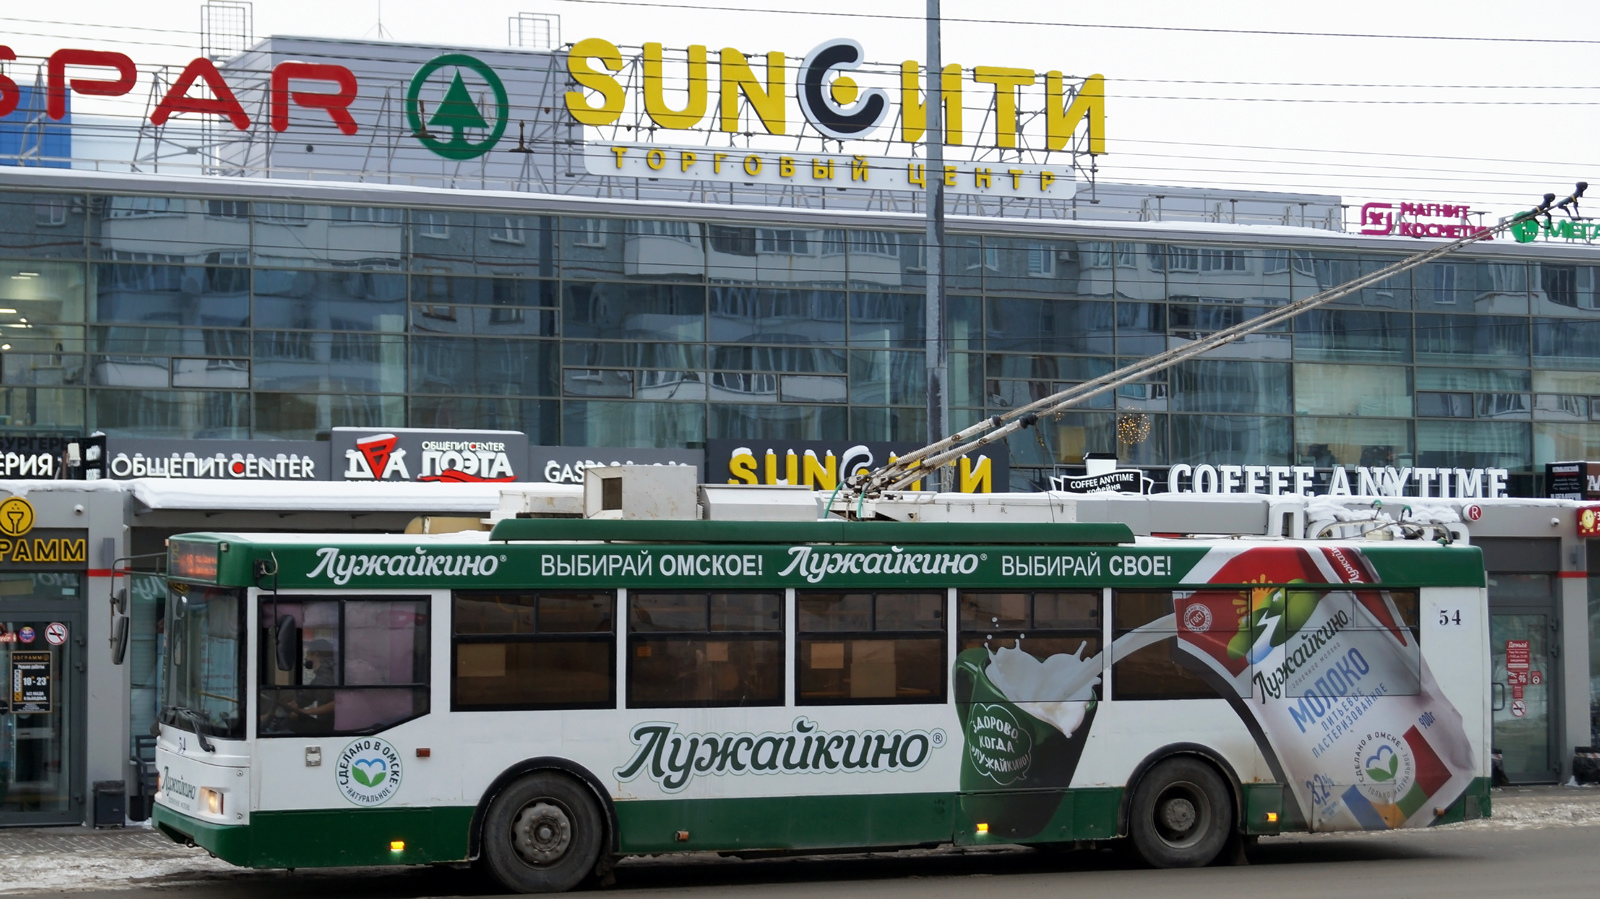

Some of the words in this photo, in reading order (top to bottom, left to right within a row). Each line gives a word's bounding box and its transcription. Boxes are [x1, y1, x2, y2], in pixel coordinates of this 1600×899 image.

[0, 44, 358, 136] PAR
[610, 146, 869, 182] ТОРГОВЫЙ
[908, 163, 1056, 192] ЦЕНТР
[1401, 202, 1470, 219] МАГНИТ
[1400, 222, 1494, 241] КОСМЕТИ
[421, 449, 515, 480] ПОЭТА
[1070, 479, 1098, 489] COFFEE
[1099, 473, 1134, 485] ANYTIME
[1168, 463, 1315, 497] COFFEE
[1328, 466, 1509, 498] ANYTIME
[541, 550, 653, 577] ВЫБИРАЙ
[659, 554, 764, 577] ОМСКОЕ!
[1001, 551, 1102, 577] ВЫБИРАЙ
[1109, 555, 1172, 576] СВОЕ!
[1190, 611, 1204, 626] ГОСТ
[1439, 609, 1462, 626] 54
[1287, 647, 1370, 734] МОЛОКО
[1311, 682, 1388, 759] ПАСТЕРИЗОВАННОЕ
[1321, 687, 1365, 731] ПИТЬЕВОЕ
[978, 735, 1016, 754] КОГДА
[1353, 739, 1367, 783] СДЕЛАНО
[1366, 733, 1373, 741] В
[1374, 731, 1401, 748] ОМСКЕ
[338, 740, 371, 786] СДЕЛАНО
[373, 741, 382, 751] В
[381, 746, 400, 785] ОМСКЕ
[346, 786, 392, 803] НАТУРАЛЬНОЕ
